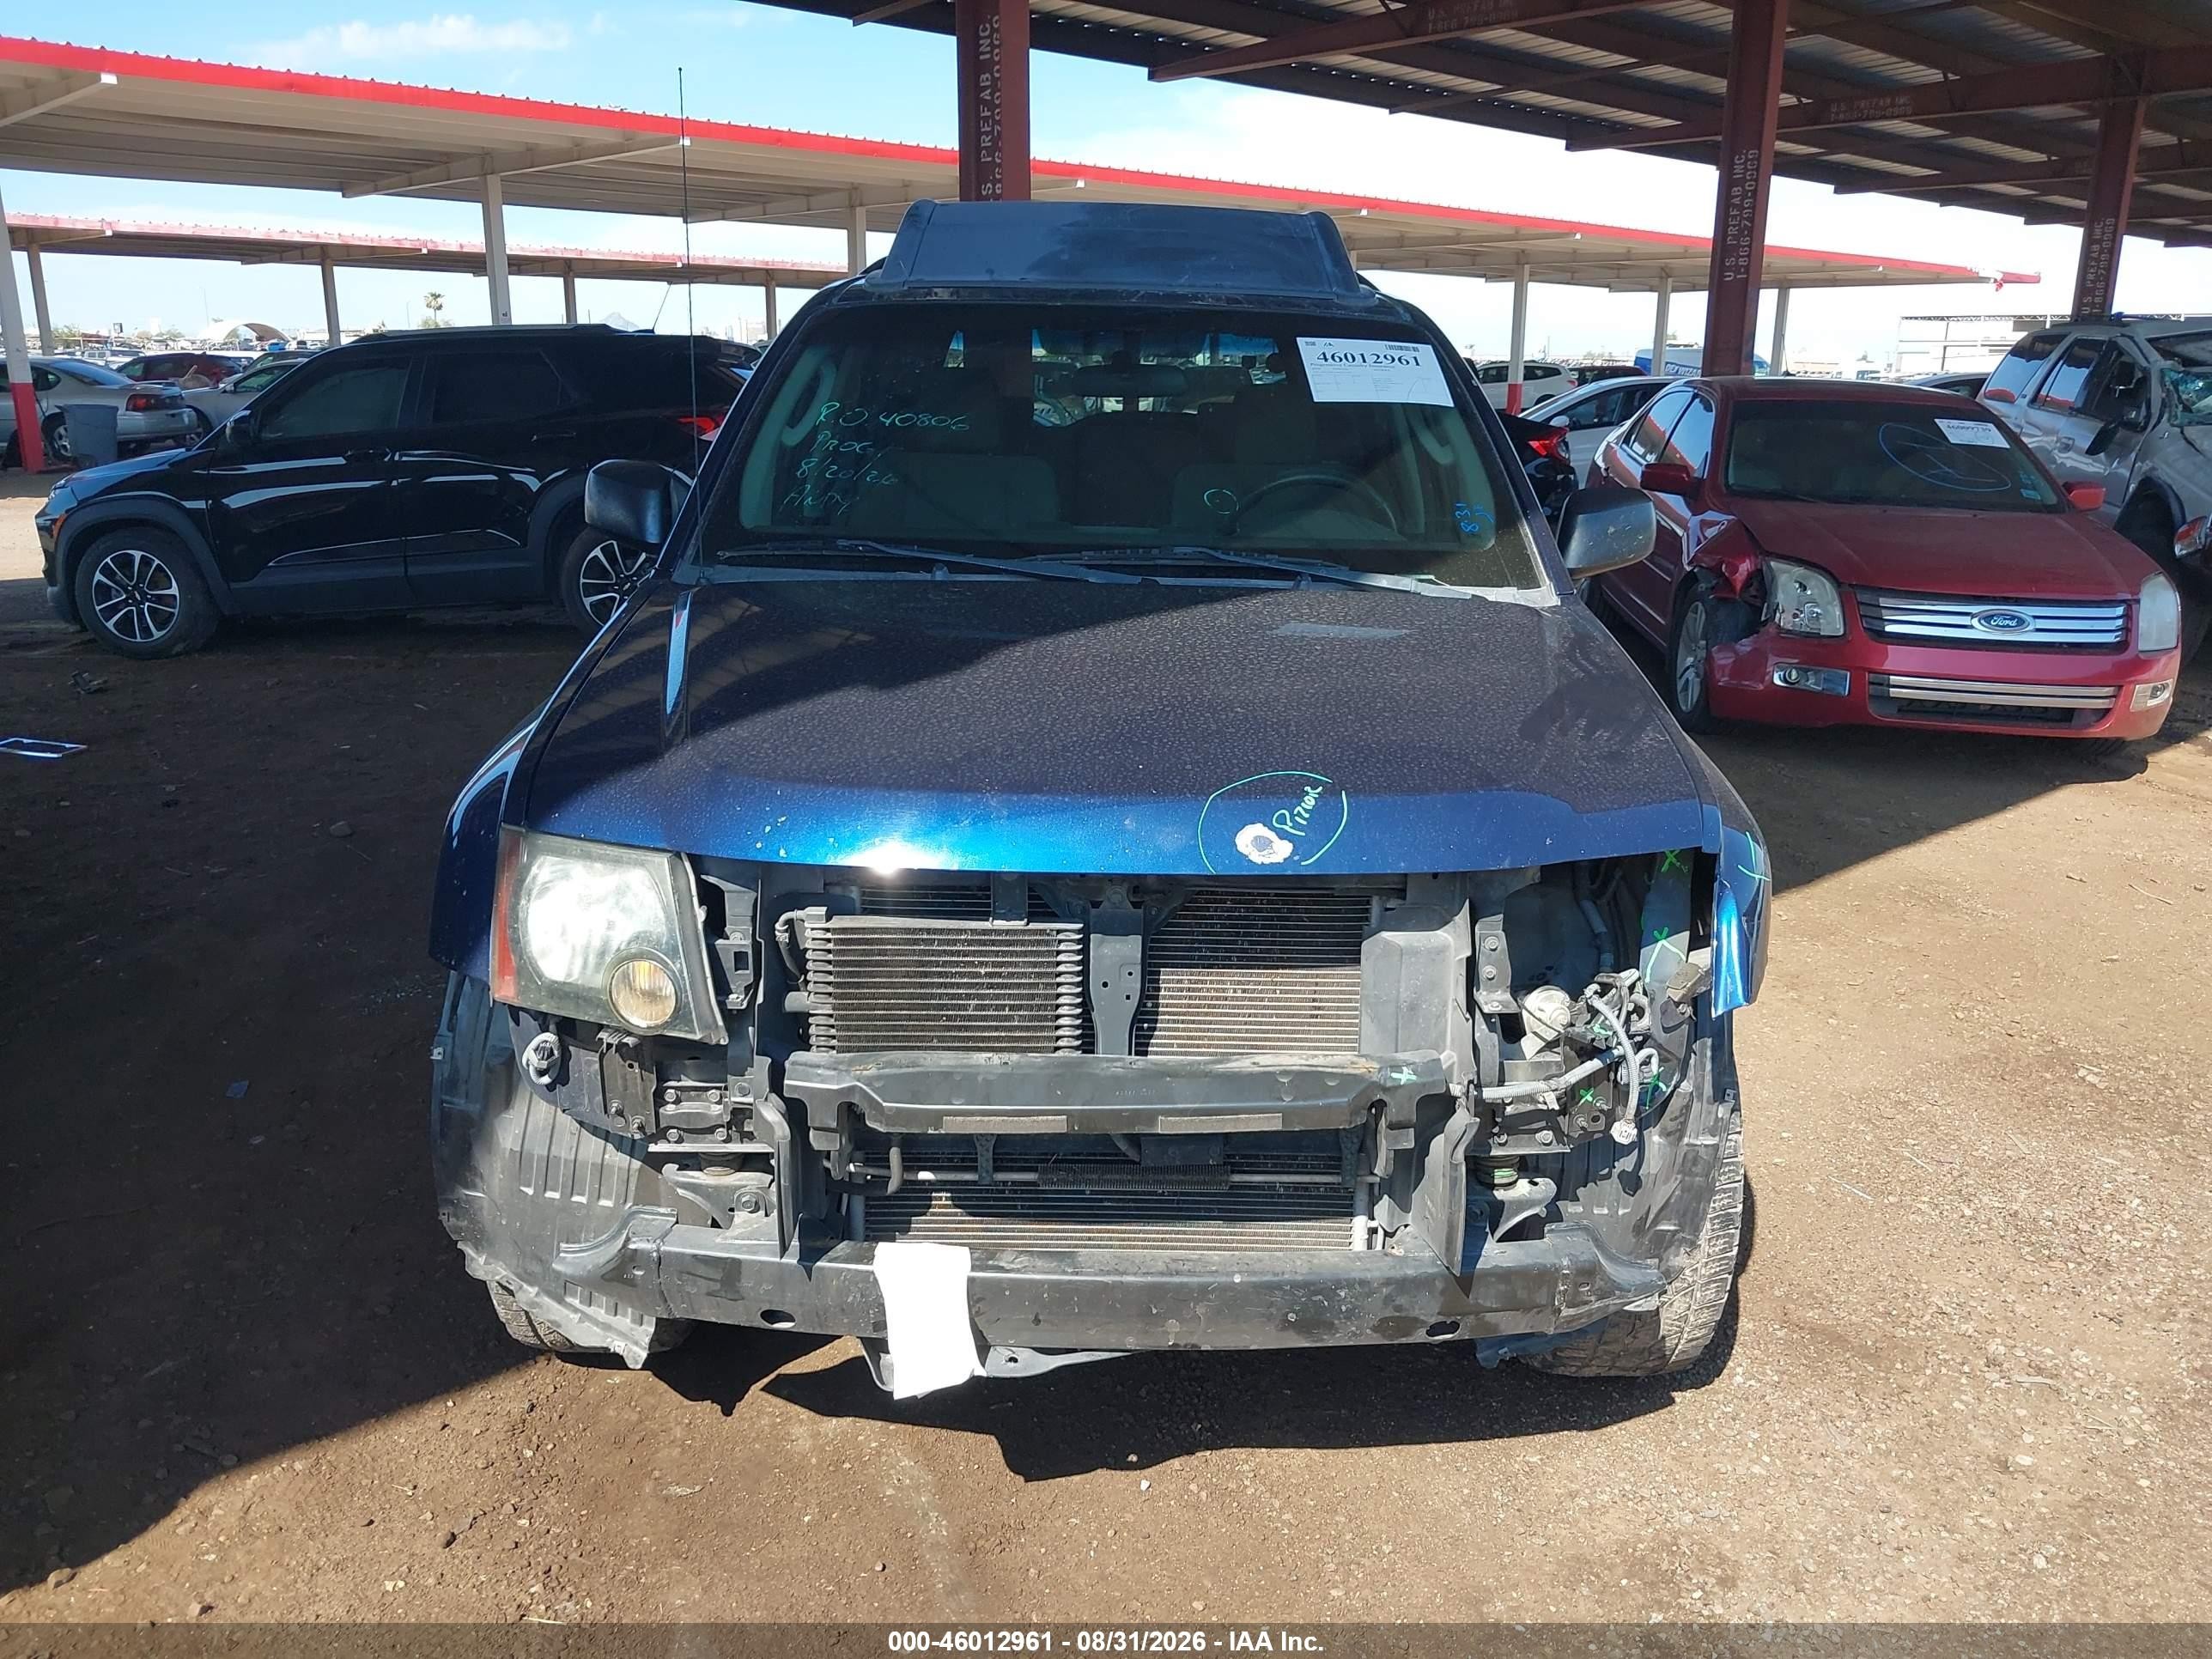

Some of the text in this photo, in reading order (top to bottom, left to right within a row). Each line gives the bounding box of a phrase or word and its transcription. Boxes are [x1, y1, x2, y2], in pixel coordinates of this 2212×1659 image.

[978, 14, 992, 61] INC.
[980, 71, 993, 163] PREFAB
[1723, 149, 1747, 282] U.S. PREFAB INC.
[2086, 245, 2100, 288] PREFAB
[1316, 350, 1422, 368] 46012961
[878, 411, 970, 431] 40806
[1990, 615, 2018, 627] Ford
